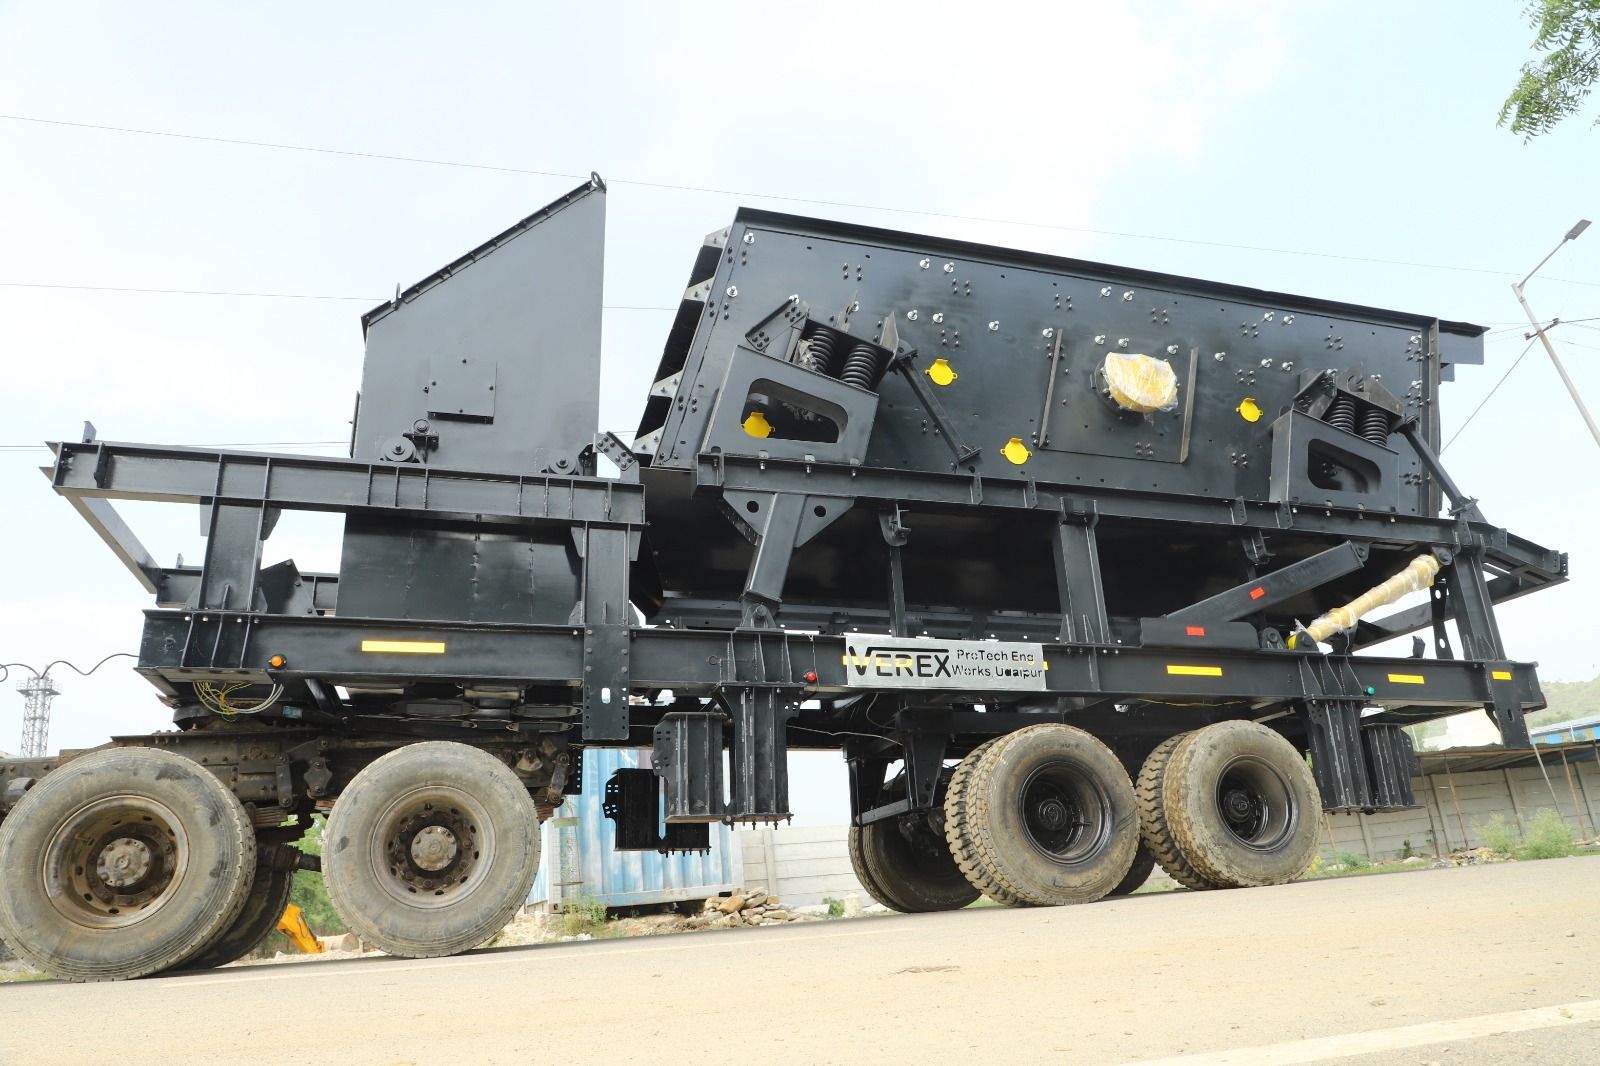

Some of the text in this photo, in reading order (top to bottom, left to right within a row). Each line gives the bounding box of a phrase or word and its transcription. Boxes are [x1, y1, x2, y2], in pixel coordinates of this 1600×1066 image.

[848, 646, 951, 677] VEREX
[957, 649, 1034, 665] ProTech Eng
